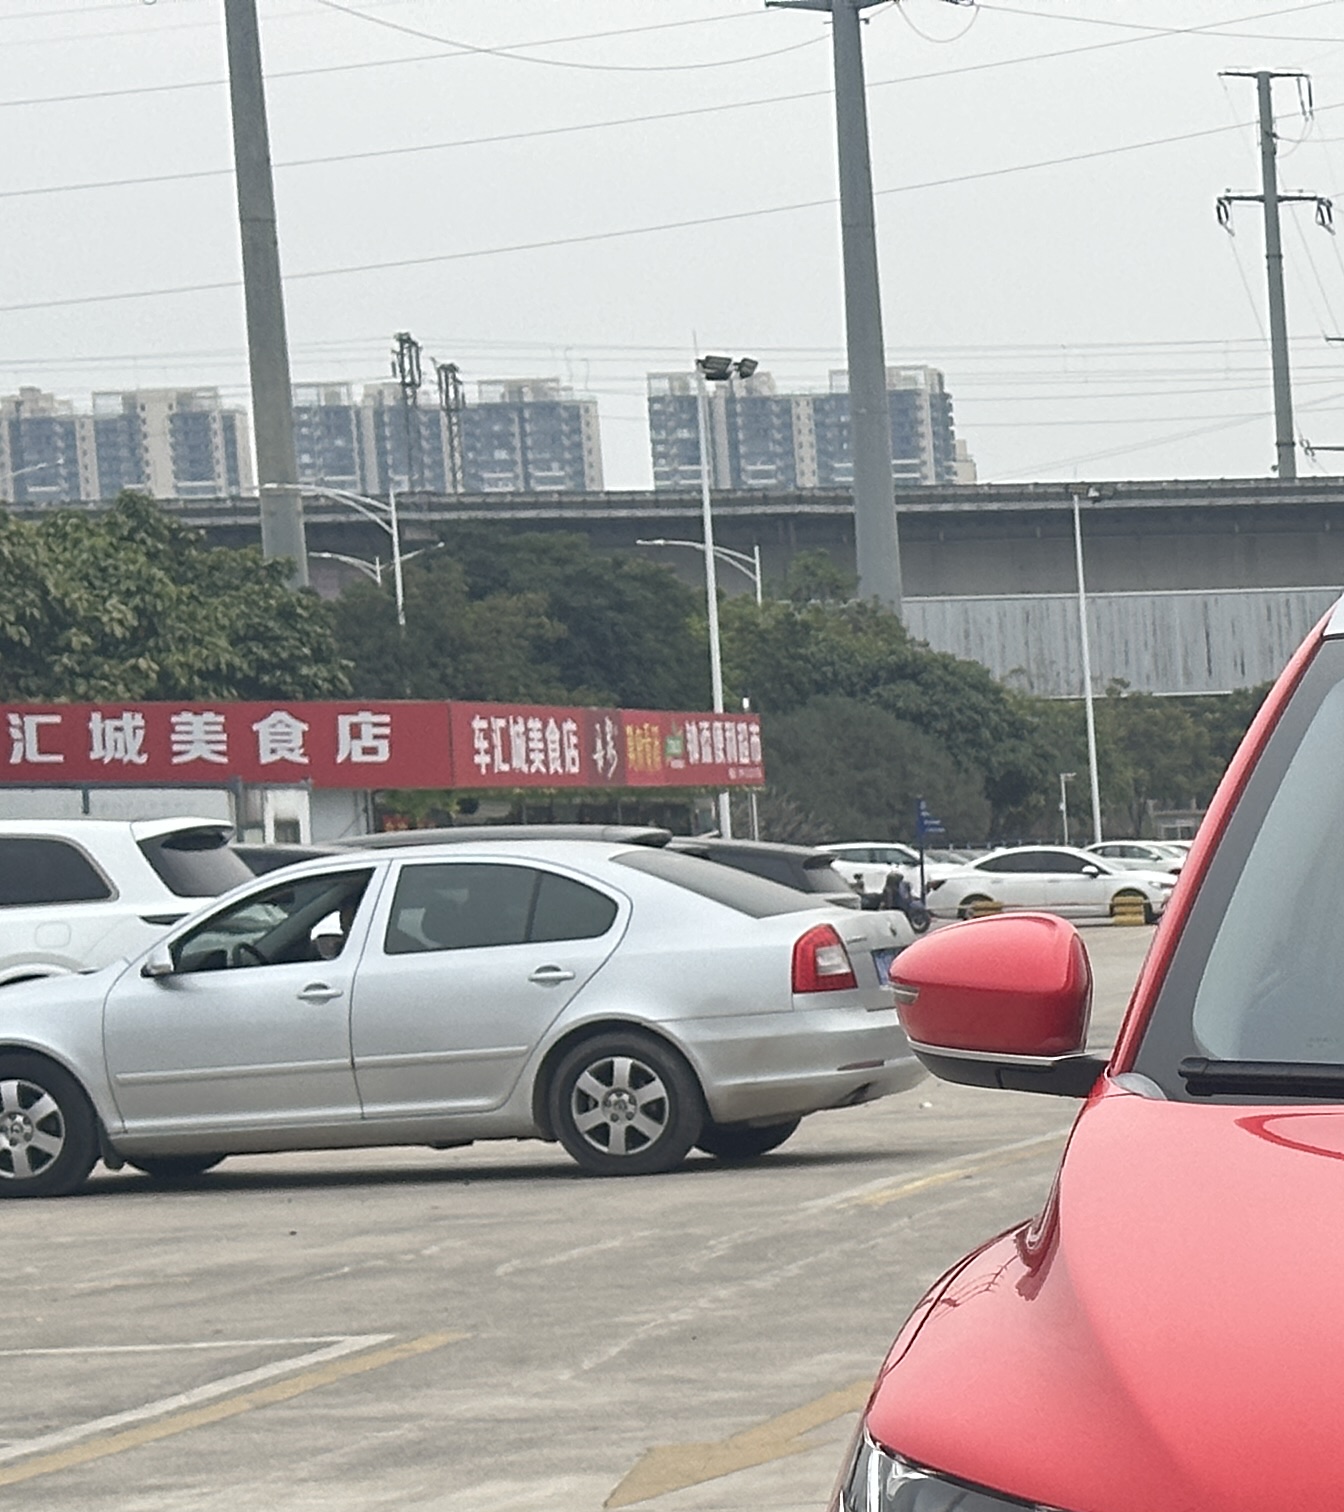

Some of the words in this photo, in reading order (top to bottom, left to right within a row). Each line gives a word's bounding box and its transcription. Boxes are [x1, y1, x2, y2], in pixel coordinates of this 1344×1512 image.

[7, 711, 392, 765] 汇城美食店
[471, 714, 580, 775] 车汇城美食店
